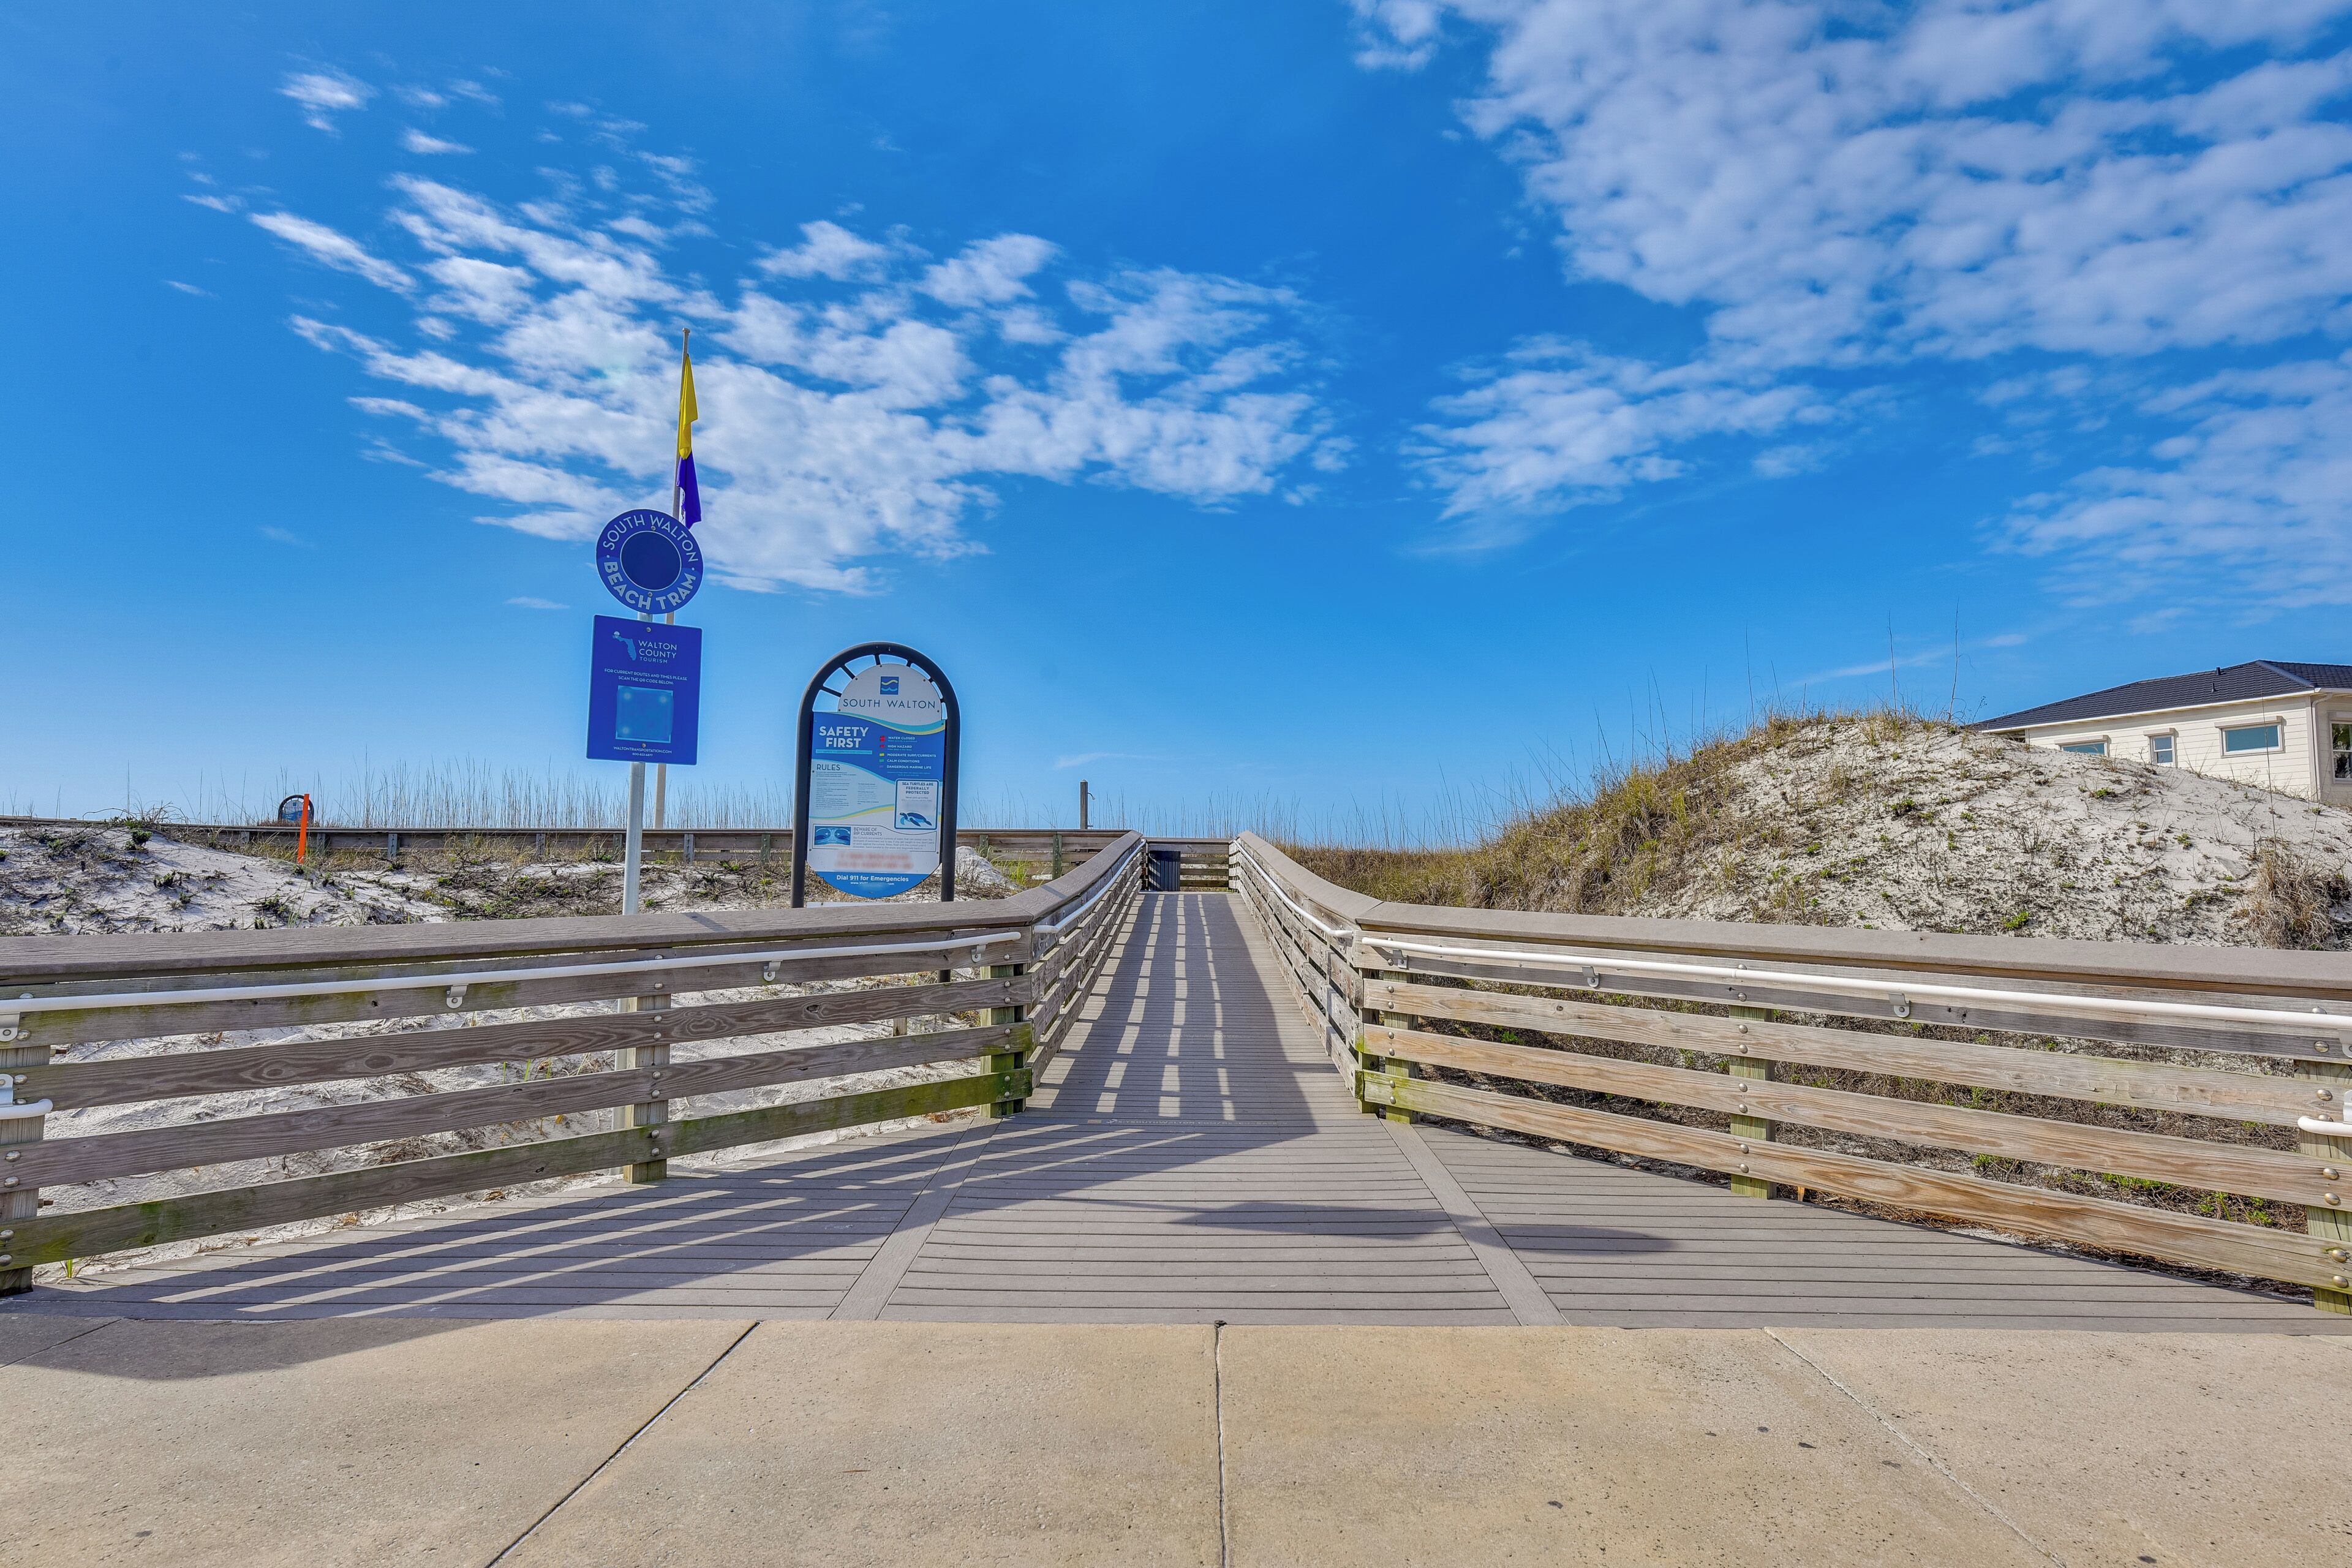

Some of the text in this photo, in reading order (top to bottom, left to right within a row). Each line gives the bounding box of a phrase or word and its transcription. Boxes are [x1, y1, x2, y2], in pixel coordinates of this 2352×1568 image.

[603, 514, 698, 562] SOUTH WALTON
[604, 562, 696, 610] BEACH TRAM
[638, 639, 677, 650] WALTON
[639, 649, 676, 658] COUNTY
[843, 699, 935, 709] SOUTH WALTON
[819, 726, 869, 737] SAFETY
[826, 737, 862, 748] FIRST
